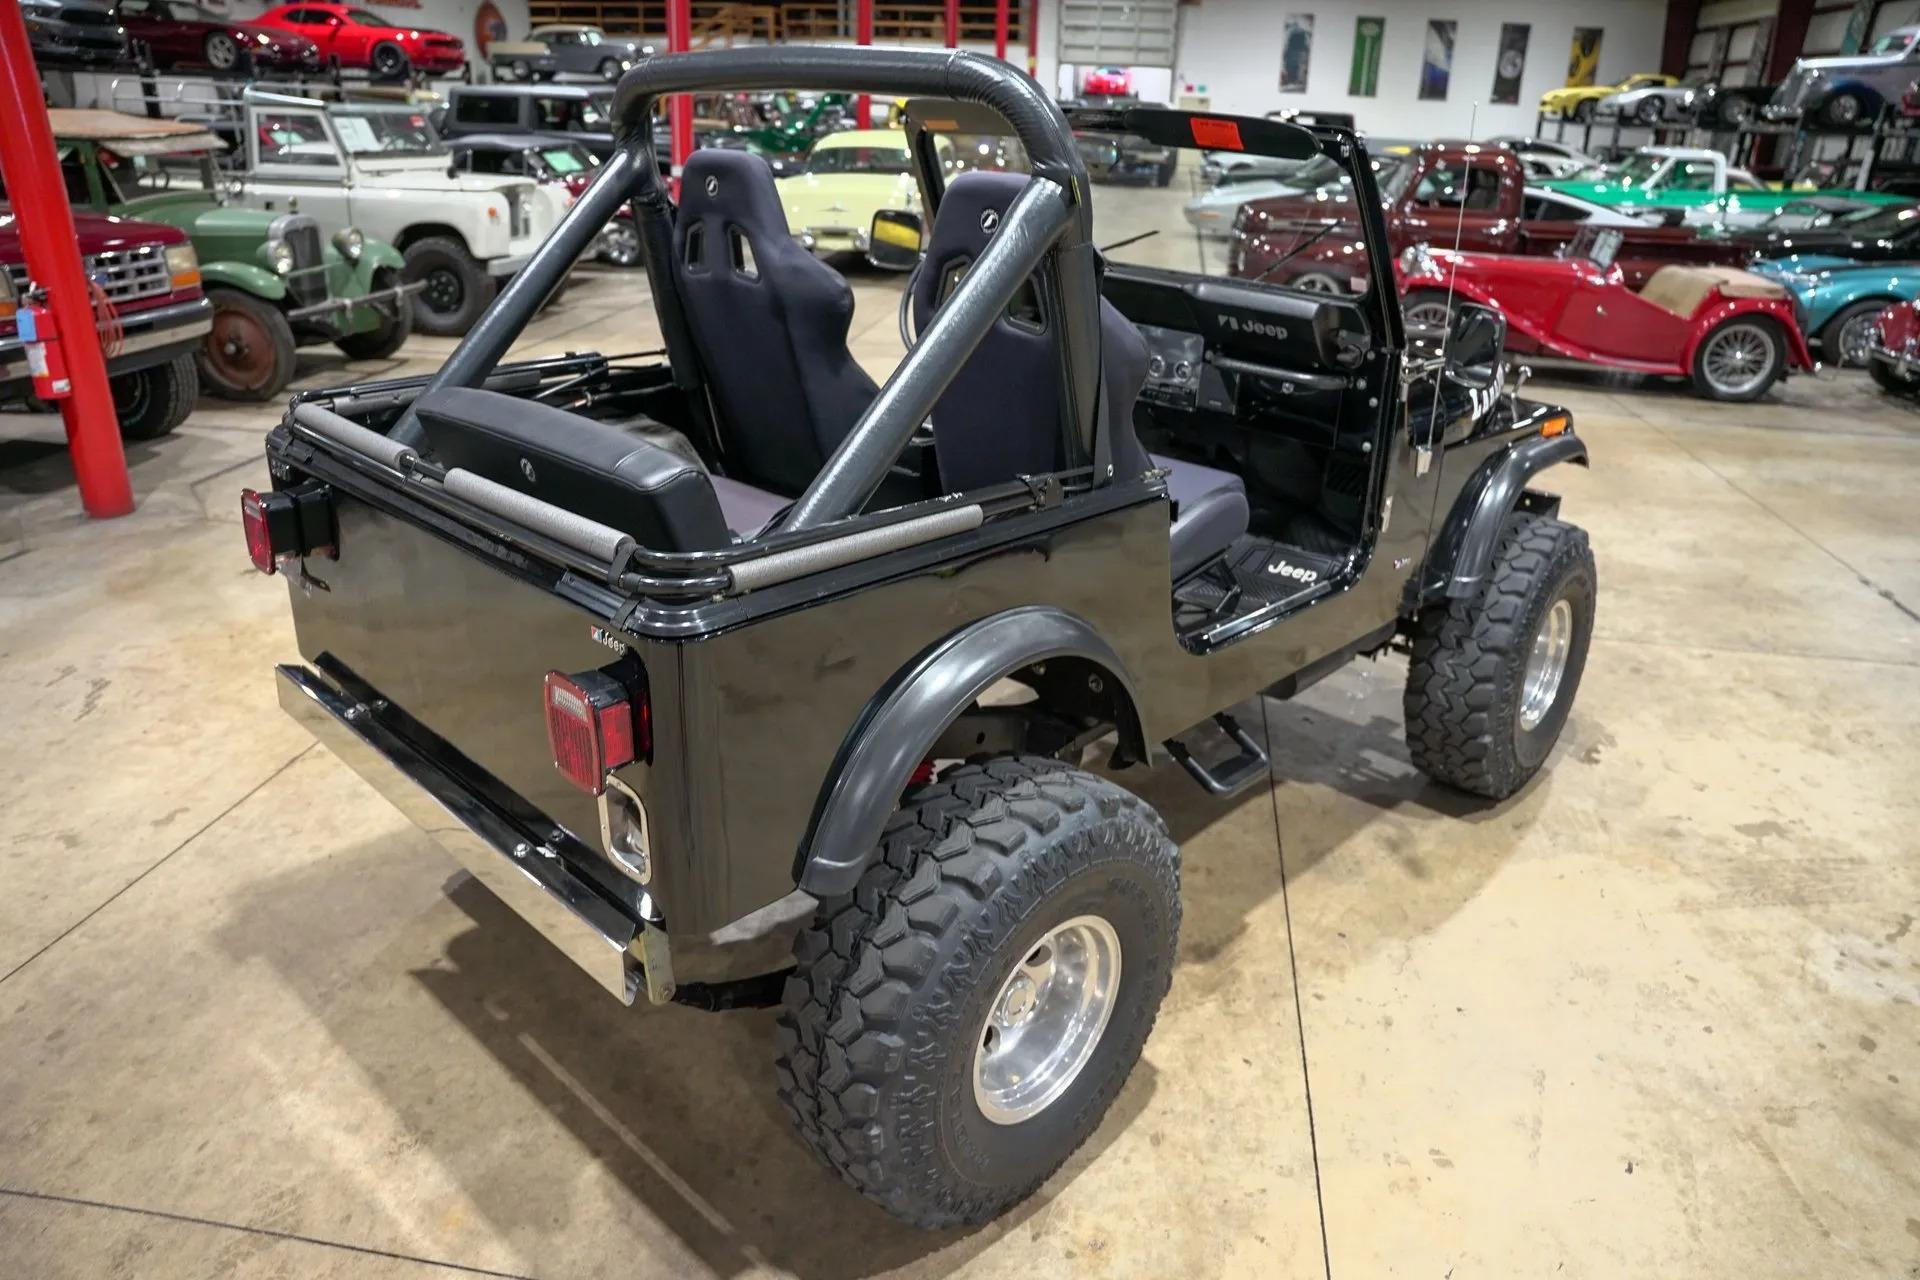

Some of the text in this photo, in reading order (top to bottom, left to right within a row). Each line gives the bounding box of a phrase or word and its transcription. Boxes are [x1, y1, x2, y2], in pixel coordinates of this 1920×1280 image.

[1241, 320, 1288, 340] Jeep
[1267, 560, 1318, 583] Jeep
[603, 631, 626, 656] Jeep
